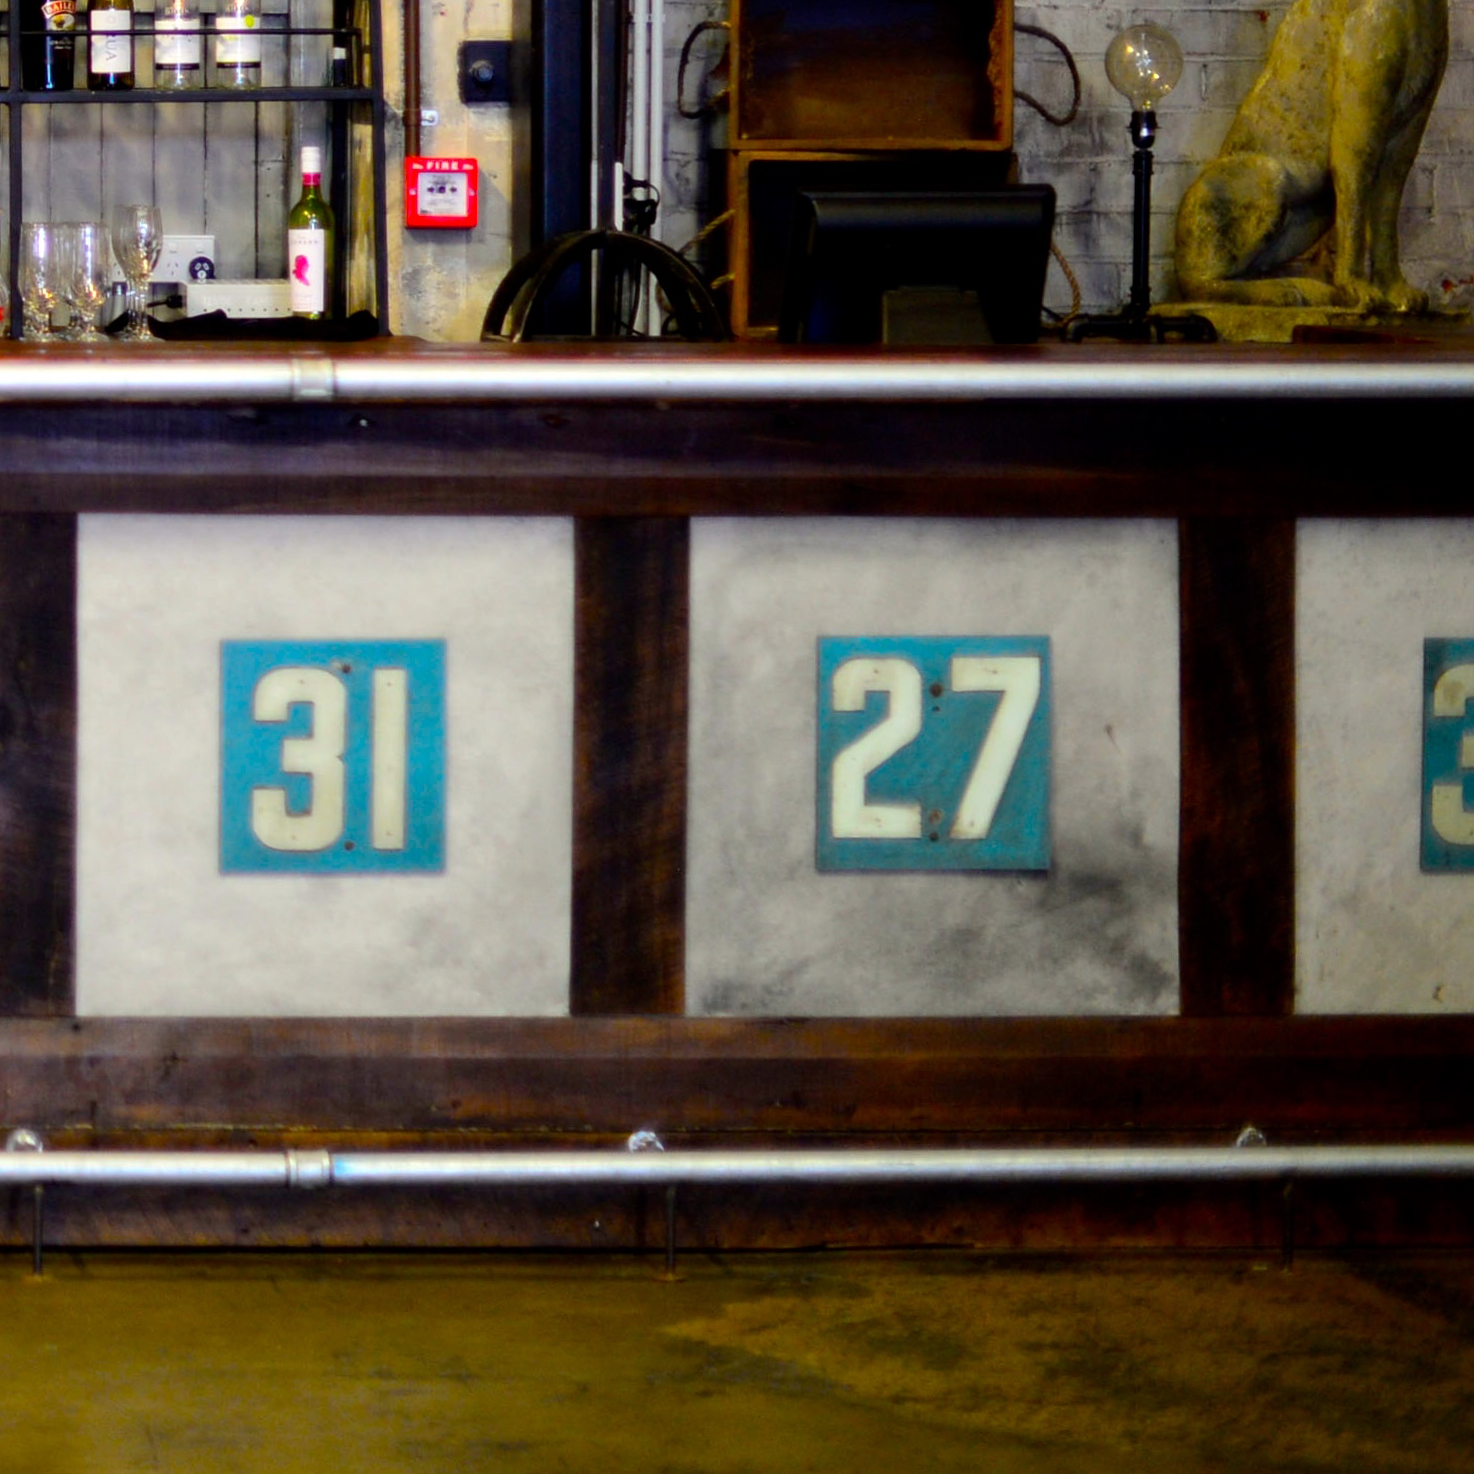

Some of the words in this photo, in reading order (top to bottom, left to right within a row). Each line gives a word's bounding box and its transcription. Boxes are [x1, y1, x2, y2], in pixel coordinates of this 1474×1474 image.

[426, 161, 459, 171] FIRE
[249, 660, 410, 855] 31
[826, 652, 1043, 846] 27
